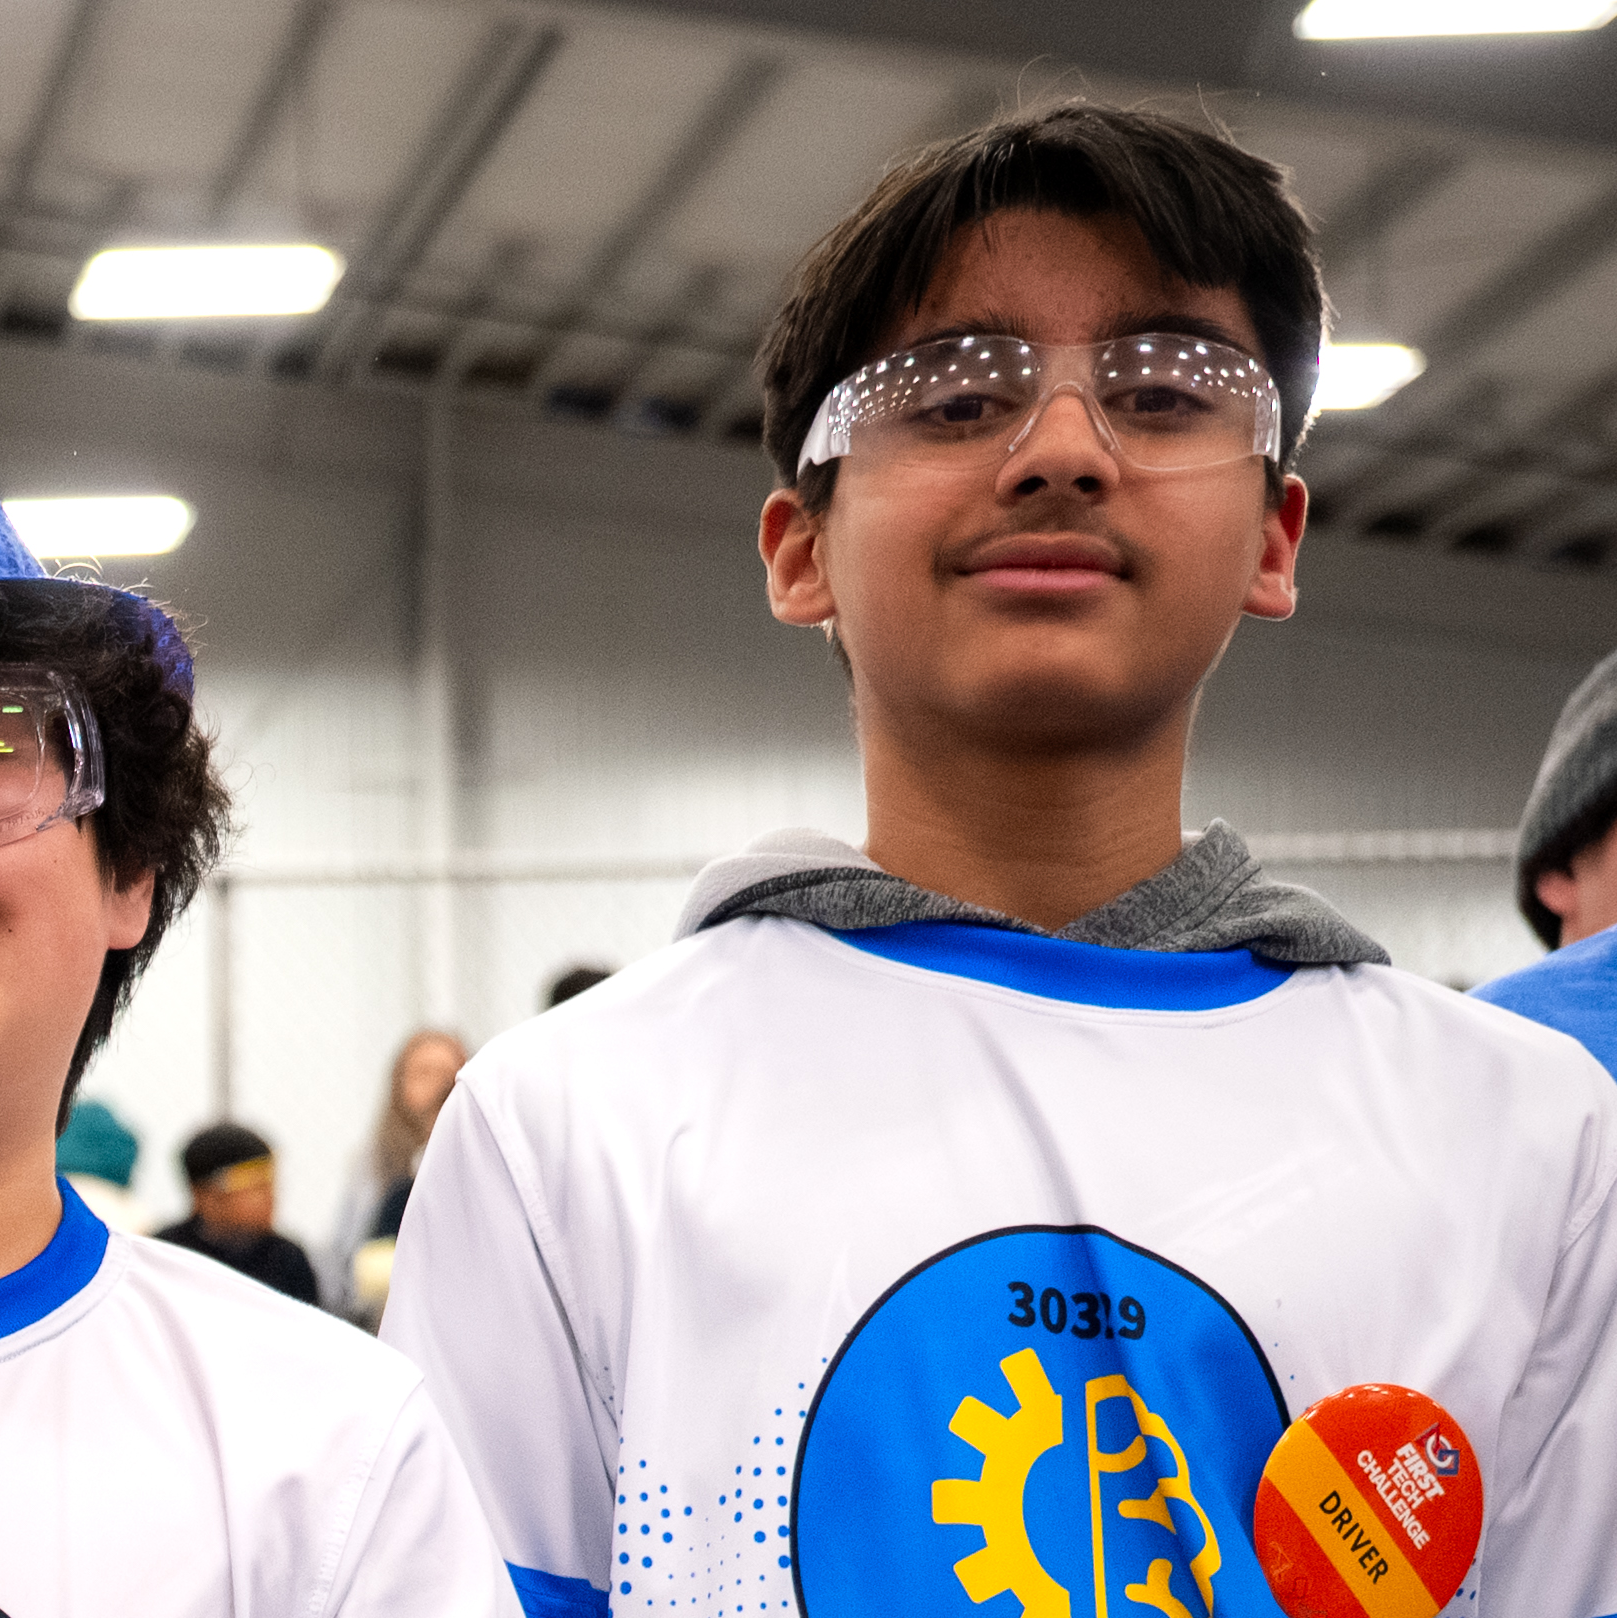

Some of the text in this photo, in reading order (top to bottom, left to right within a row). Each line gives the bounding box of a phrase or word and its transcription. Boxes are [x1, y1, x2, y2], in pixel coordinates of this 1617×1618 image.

[1357, 1449, 1431, 1550] CHALLENGE
[1387, 1458, 1426, 1510] TECH
[1396, 1442, 1445, 1501] FIRST
[1319, 1490, 1389, 1585] DRIVER
